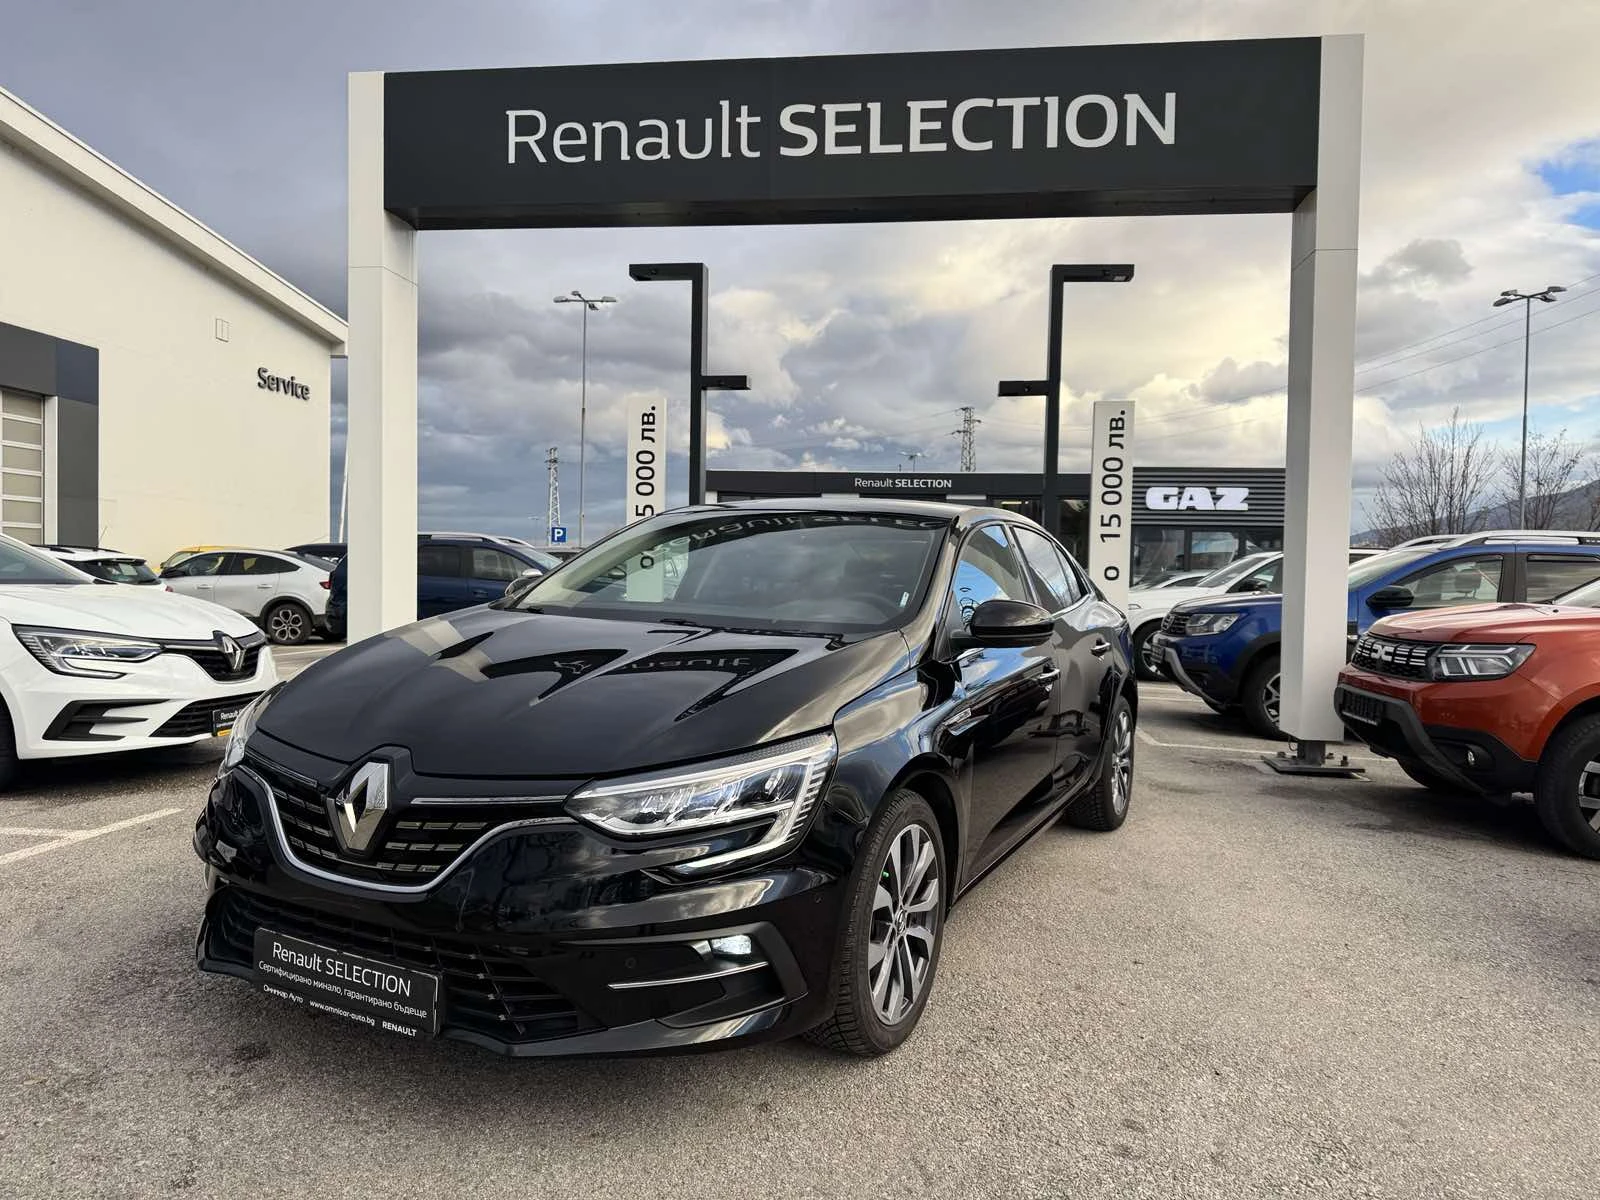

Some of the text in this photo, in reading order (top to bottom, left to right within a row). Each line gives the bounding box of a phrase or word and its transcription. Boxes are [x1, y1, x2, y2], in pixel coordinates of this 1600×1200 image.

[506, 92, 1177, 164] Renault SELECTION
[257, 367, 310, 401] Service
[641, 405, 656, 443] лв.
[1109, 410, 1126, 450] лв.
[635, 450, 656, 497] 000
[854, 478, 952, 488] Renault SELECTION
[1101, 456, 1123, 506] 000
[1146, 487, 1249, 511] GAZ
[555, 528, 564, 541] P
[1100, 513, 1122, 543] 15
[273, 942, 411, 997] Renault SELECTION
[258, 960, 428, 1018] Сертифицирано минало, гарантирано бъдеще
[382, 1021, 417, 1037] RENAULT
